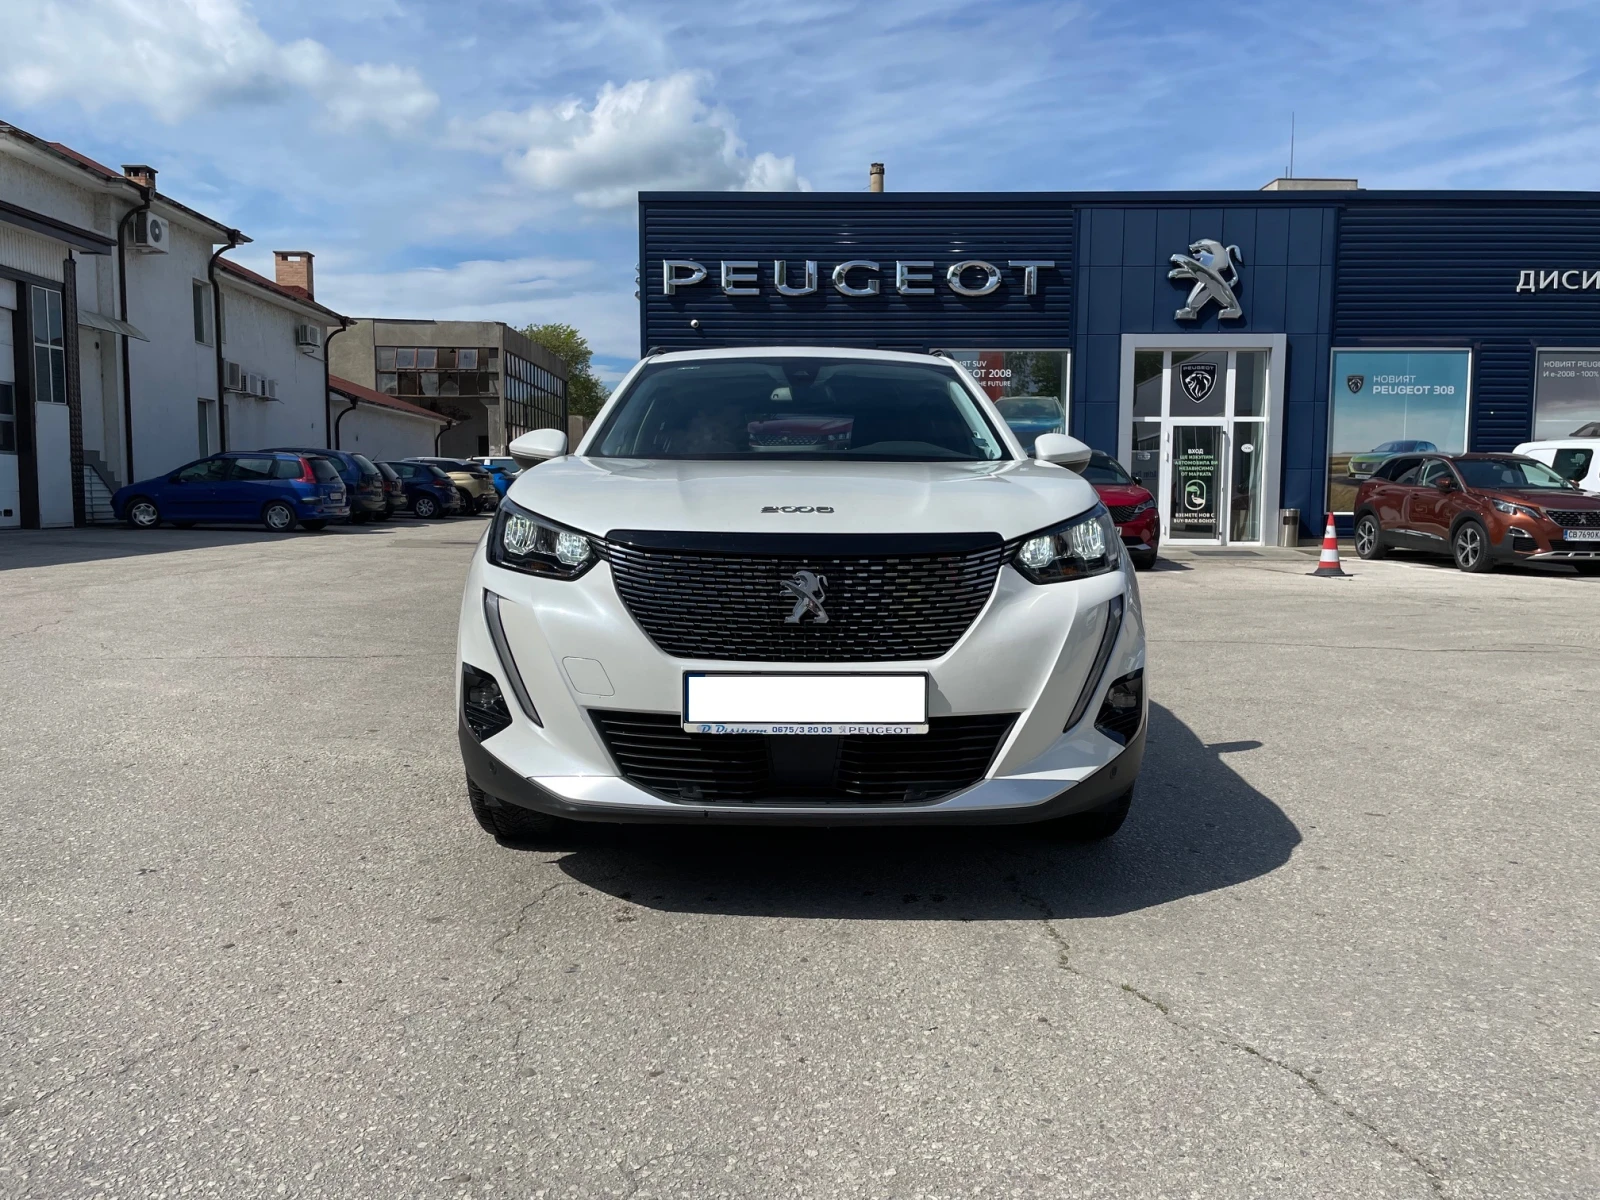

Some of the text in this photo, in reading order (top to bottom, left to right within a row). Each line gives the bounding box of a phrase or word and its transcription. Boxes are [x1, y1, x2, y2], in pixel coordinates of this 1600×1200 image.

[662, 259, 1056, 297] PEUGEOT
[1543, 360, 1576, 368] НОВИЯТ
[989, 369, 1011, 378] 2008
[1580, 370, 1600, 378] 100%
[1373, 375, 1416, 383] НОВИЯТ
[1372, 385, 1455, 395] PEUGEOT 308
[760, 506, 835, 514] 2008
[772, 726, 805, 734] 0675/3
[807, 726, 819, 734] 20
[821, 726, 833, 734] 03
[848, 726, 911, 734] PEUGEOT
